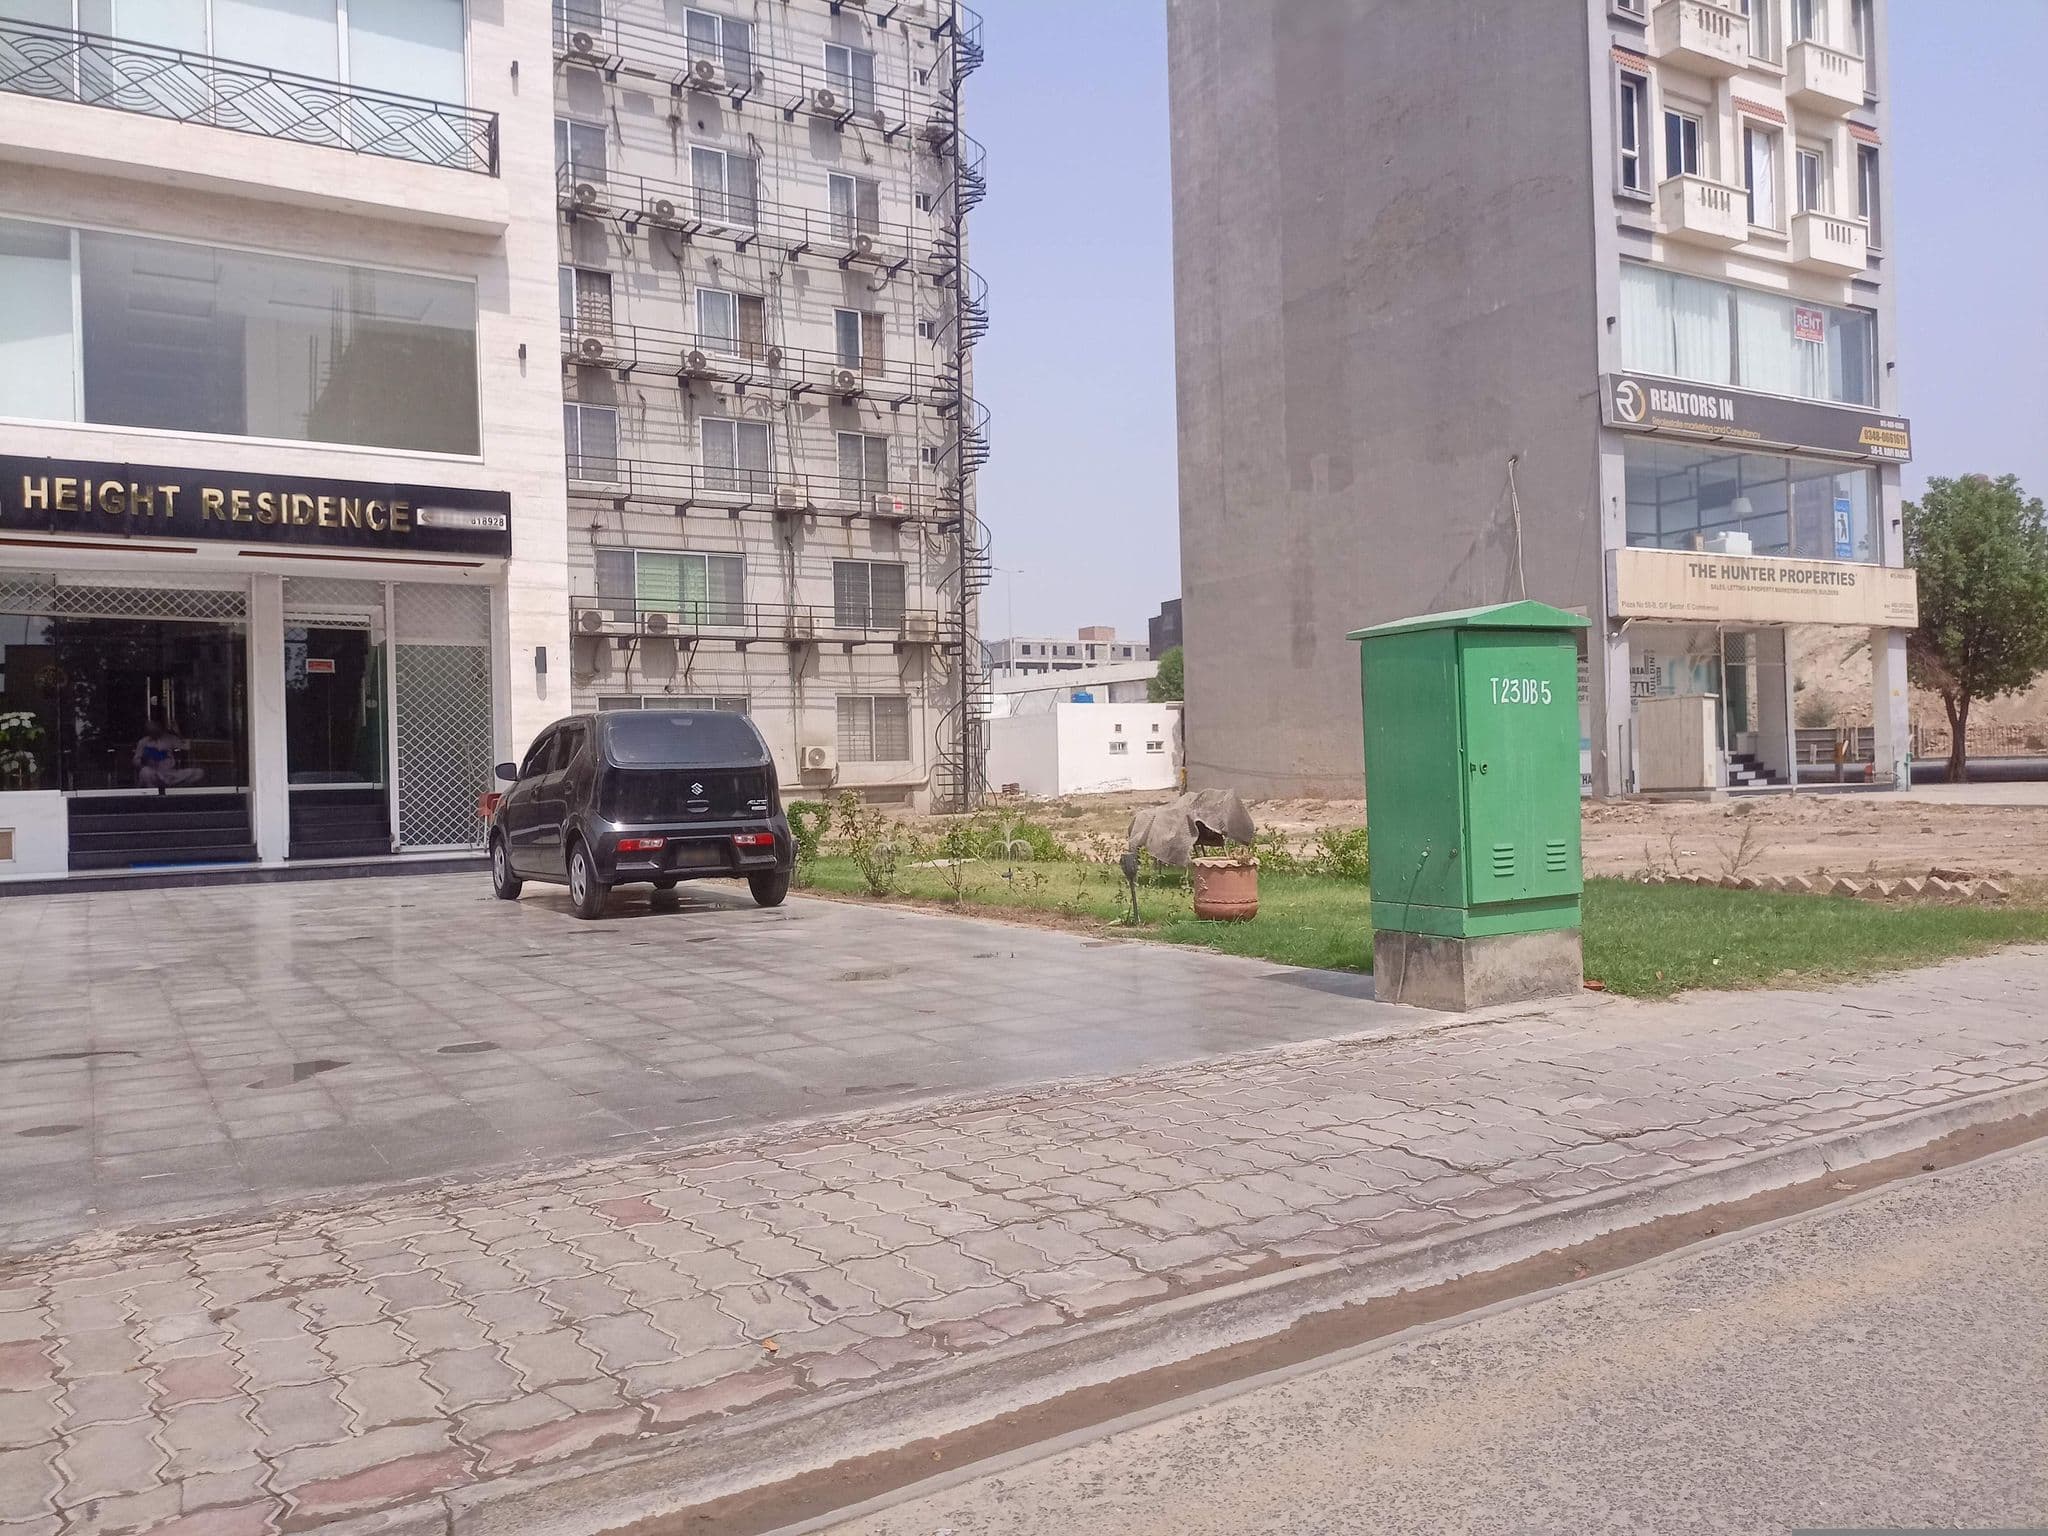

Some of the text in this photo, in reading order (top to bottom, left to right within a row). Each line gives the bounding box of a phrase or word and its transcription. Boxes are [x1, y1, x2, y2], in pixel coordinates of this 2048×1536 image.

[1796, 314, 1822, 330] RENT
[1650, 388, 1735, 421] REALTORS IN
[23, 475, 182, 517] HEIGHT
[202, 488, 411, 533] RESIDENCE
[1689, 563, 1856, 587] THE HUNTER PROPERTIES
